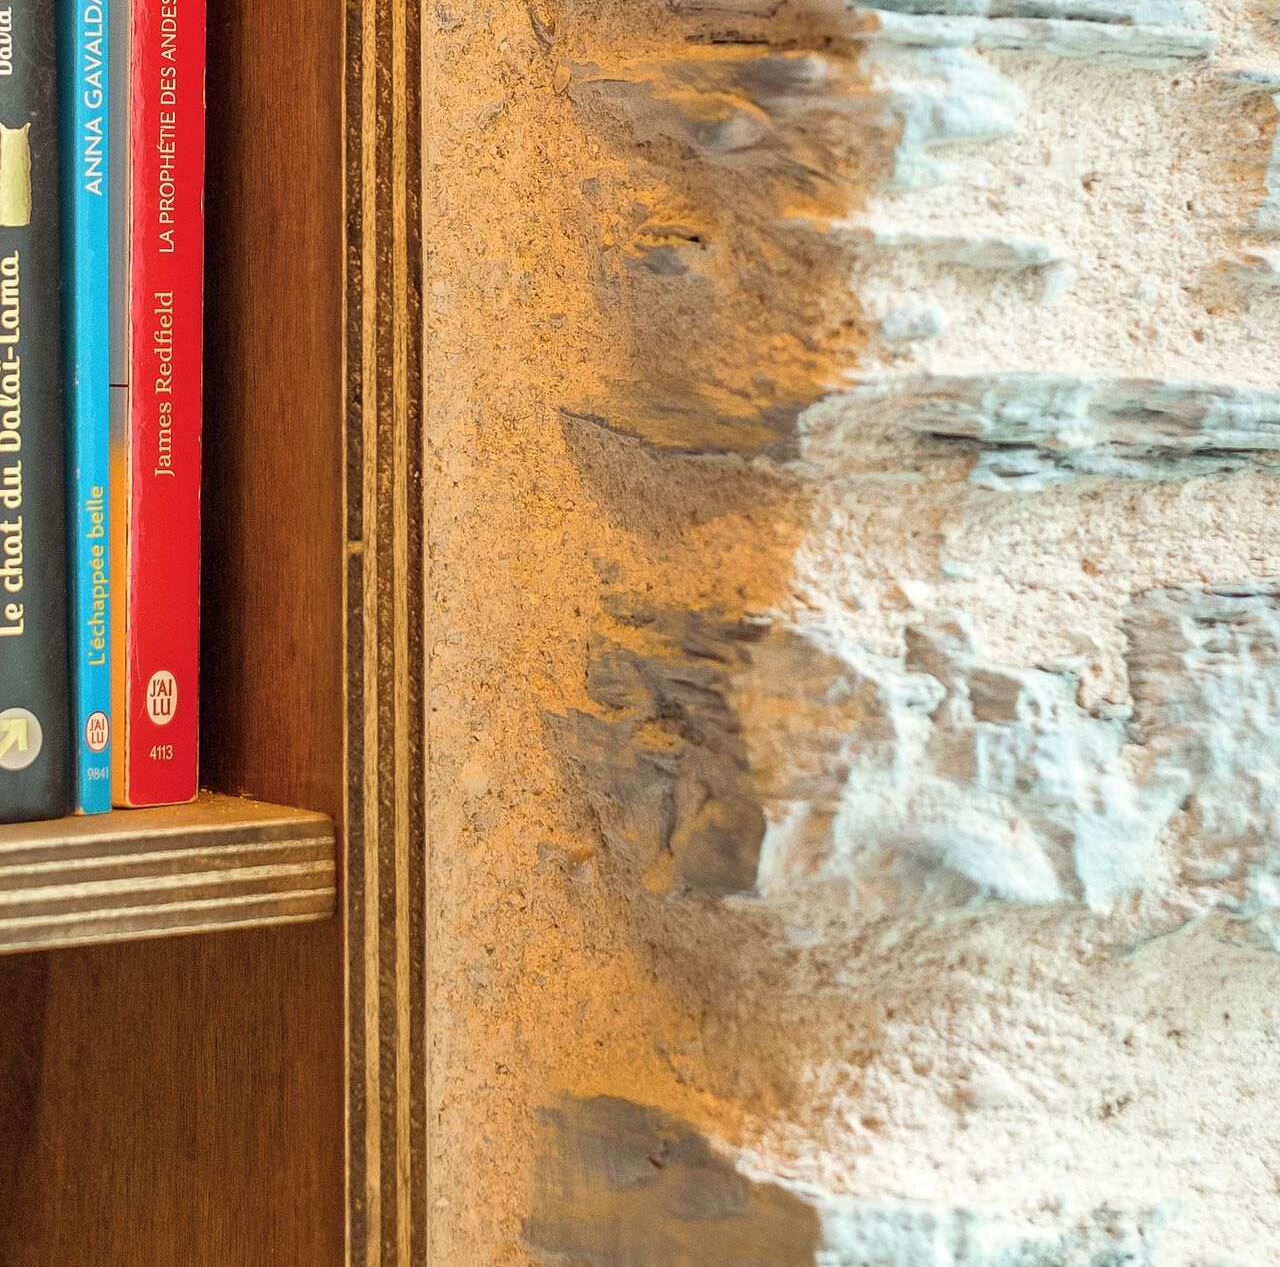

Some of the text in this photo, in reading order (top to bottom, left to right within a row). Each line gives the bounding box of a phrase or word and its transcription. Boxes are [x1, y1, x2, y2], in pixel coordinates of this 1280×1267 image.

[161, 66, 176, 105] DES
[84, 117, 103, 196] ANNA
[157, 111, 176, 224] PROPHÉTIE
[159, 229, 175, 253] LA
[154, 291, 175, 477] James Redfield
[86, 485, 109, 666] L'échappée belle
[152, 698, 171, 716] LU
[91, 731, 104, 744] LU
[149, 744, 174, 760] 4113
[87, 766, 109, 781] 9841
